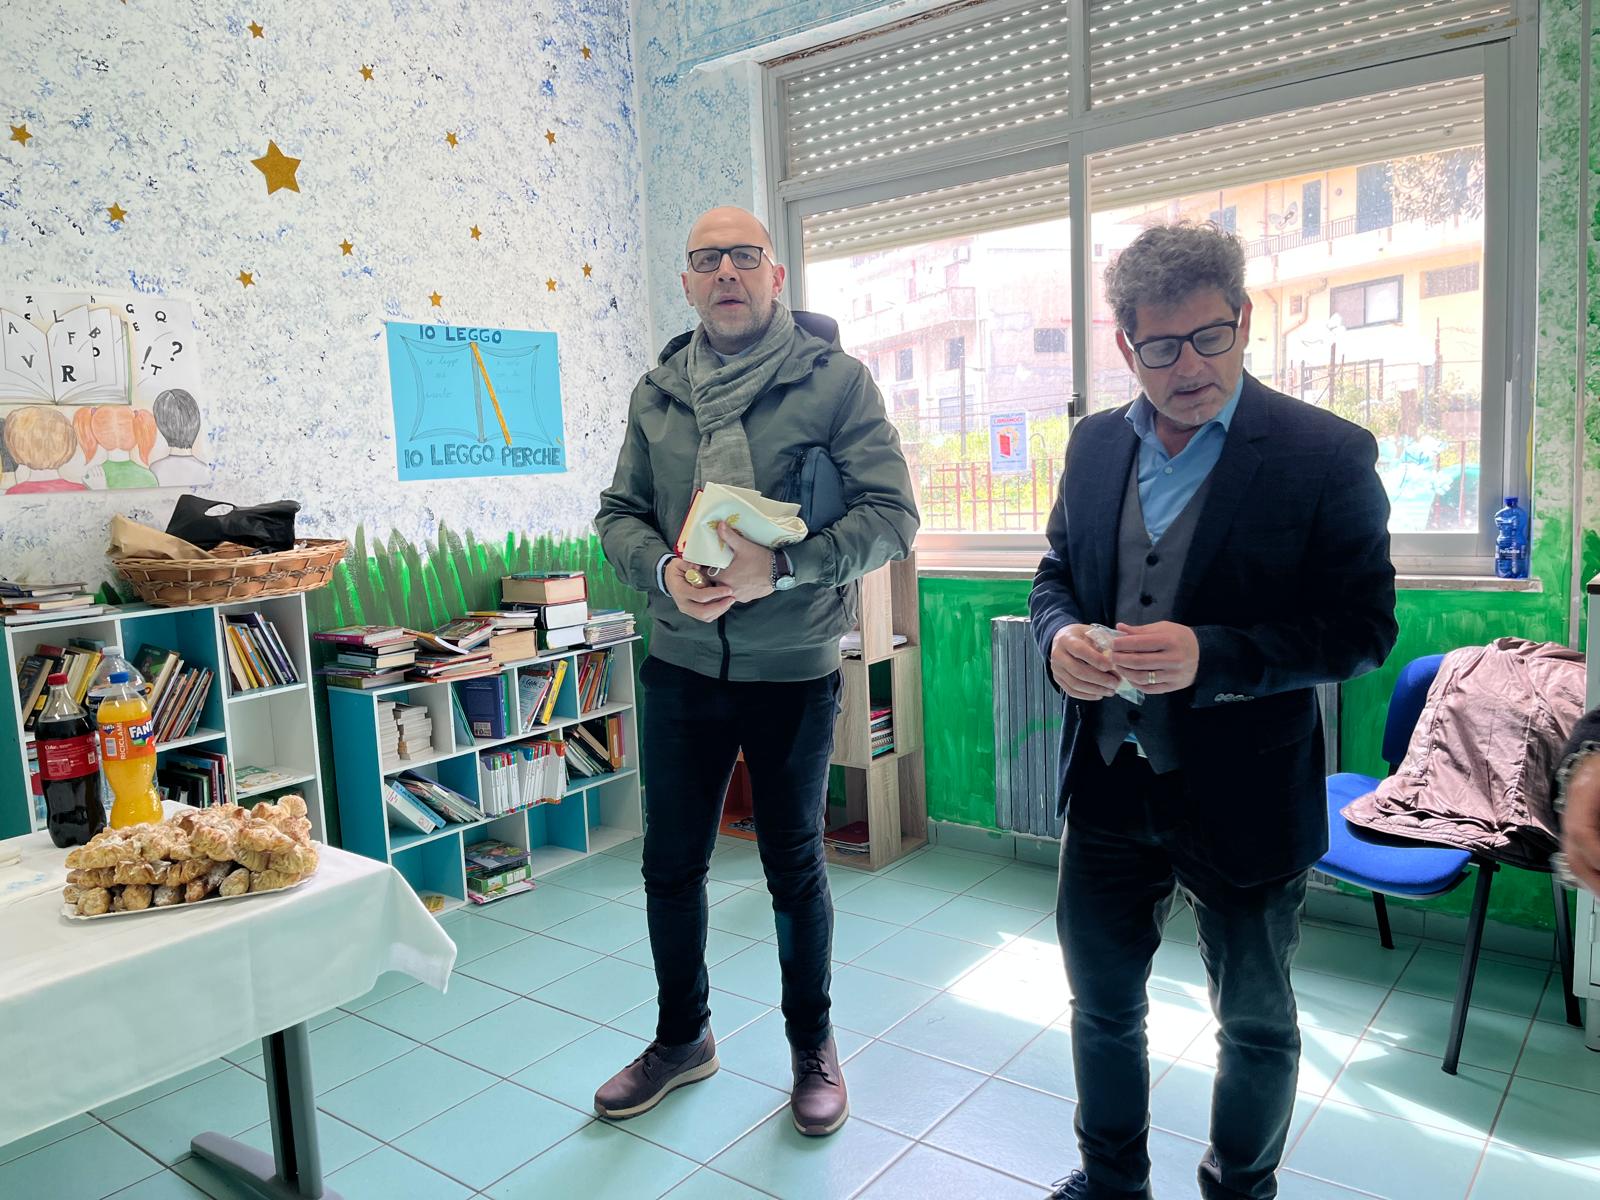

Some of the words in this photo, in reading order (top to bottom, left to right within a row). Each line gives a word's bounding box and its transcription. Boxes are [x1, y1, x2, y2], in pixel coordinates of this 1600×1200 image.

[53, 309, 64, 323] L
[154, 310, 167, 323] Q
[8, 321, 19, 335] A
[88, 326, 101, 339] B
[132, 321, 140, 332] E
[68, 331, 76, 345] F
[419, 325, 436, 340] IO
[445, 327, 502, 344] LEGGO
[21, 354, 34, 369] V
[61, 364, 77, 383] R
[150, 363, 162, 376] T
[404, 448, 424, 469] IO
[430, 443, 494, 466] LEGGO
[501, 446, 561, 468] PERCHE
